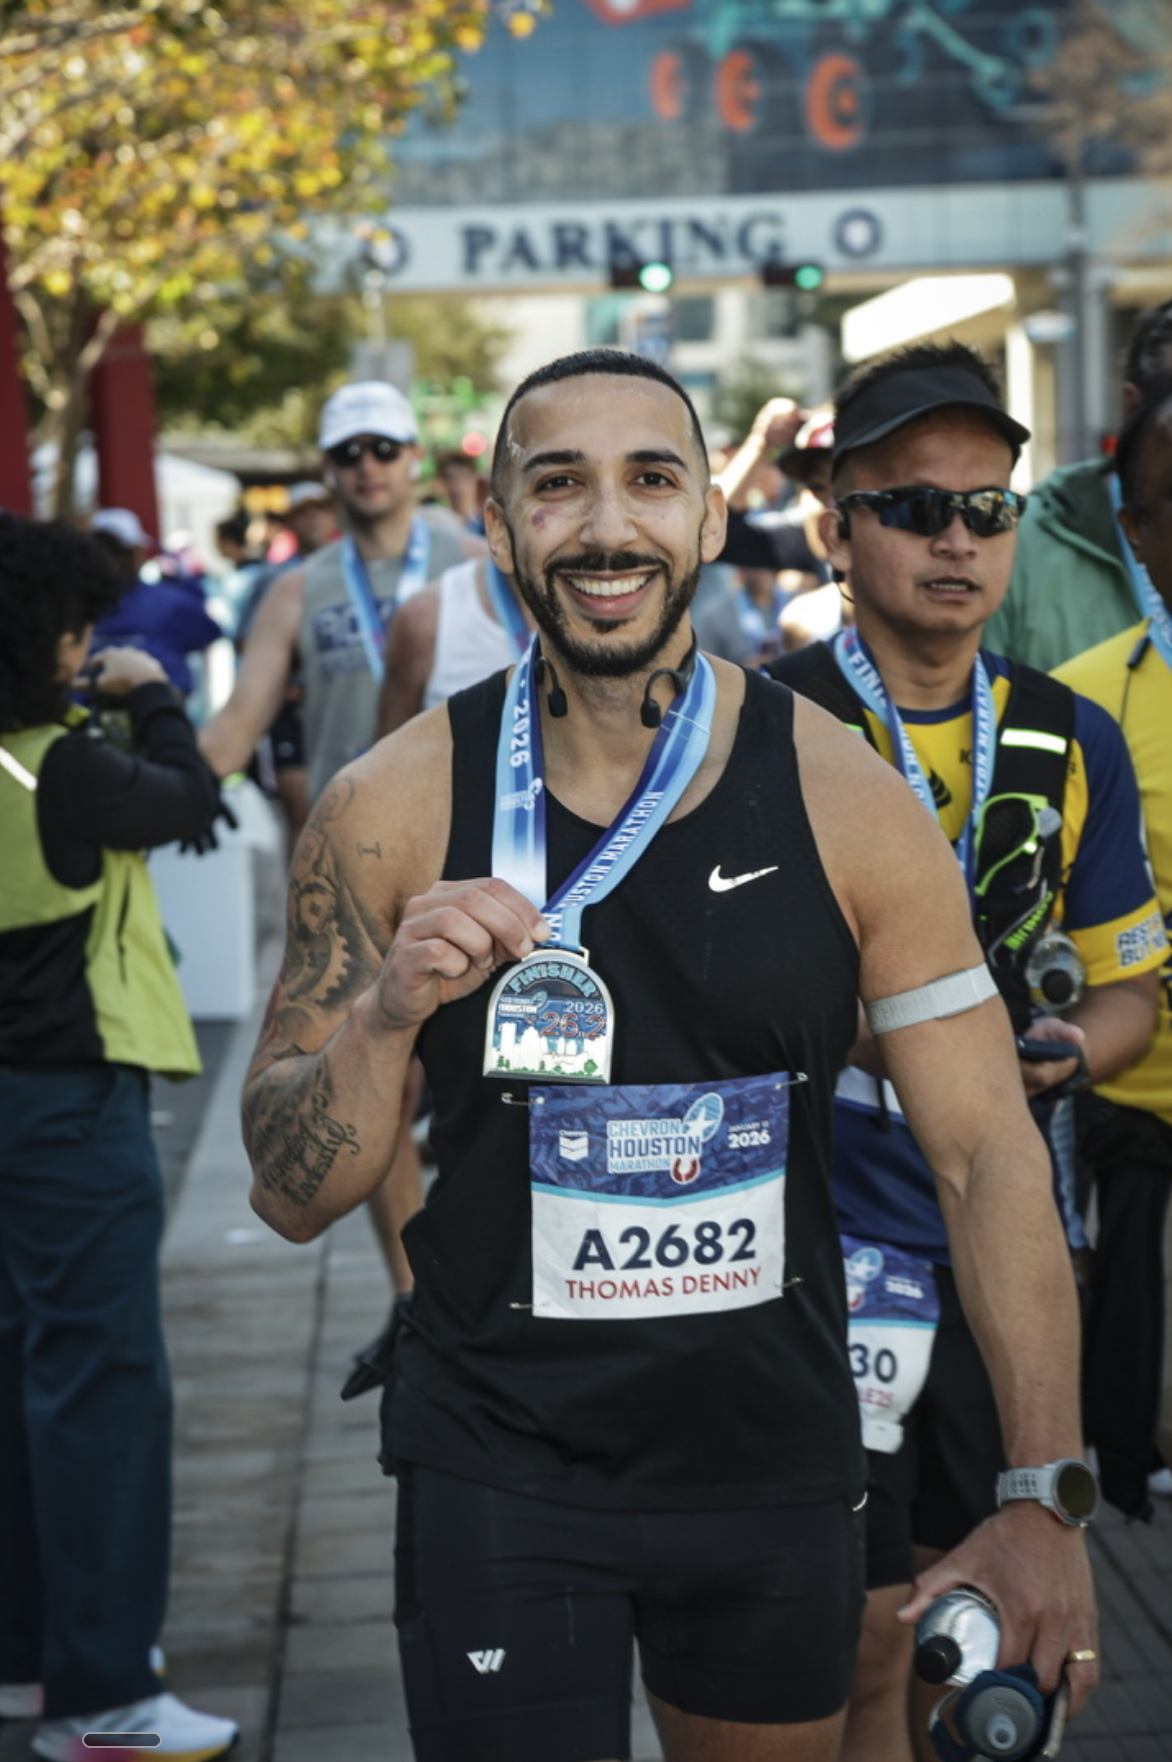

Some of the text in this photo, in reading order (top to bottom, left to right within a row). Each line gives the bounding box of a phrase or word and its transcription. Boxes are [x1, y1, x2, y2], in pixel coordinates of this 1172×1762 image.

[460, 211, 784, 273] PARKING
[510, 699, 531, 768] 2026
[599, 790, 665, 861] MARATHON
[508, 963, 597, 998] FINISHER
[564, 1001, 604, 1014] 2026
[541, 1012, 606, 1039] 26.2
[609, 1119, 682, 1138] CHEVRON
[728, 1130, 771, 1148] 2026
[609, 1135, 700, 1158] HOUSTON
[609, 1157, 670, 1172] MARATHON
[572, 1218, 756, 1271] A2682
[565, 1266, 761, 1300] THOMAS DENNY
[849, 1343, 897, 1384] 30
